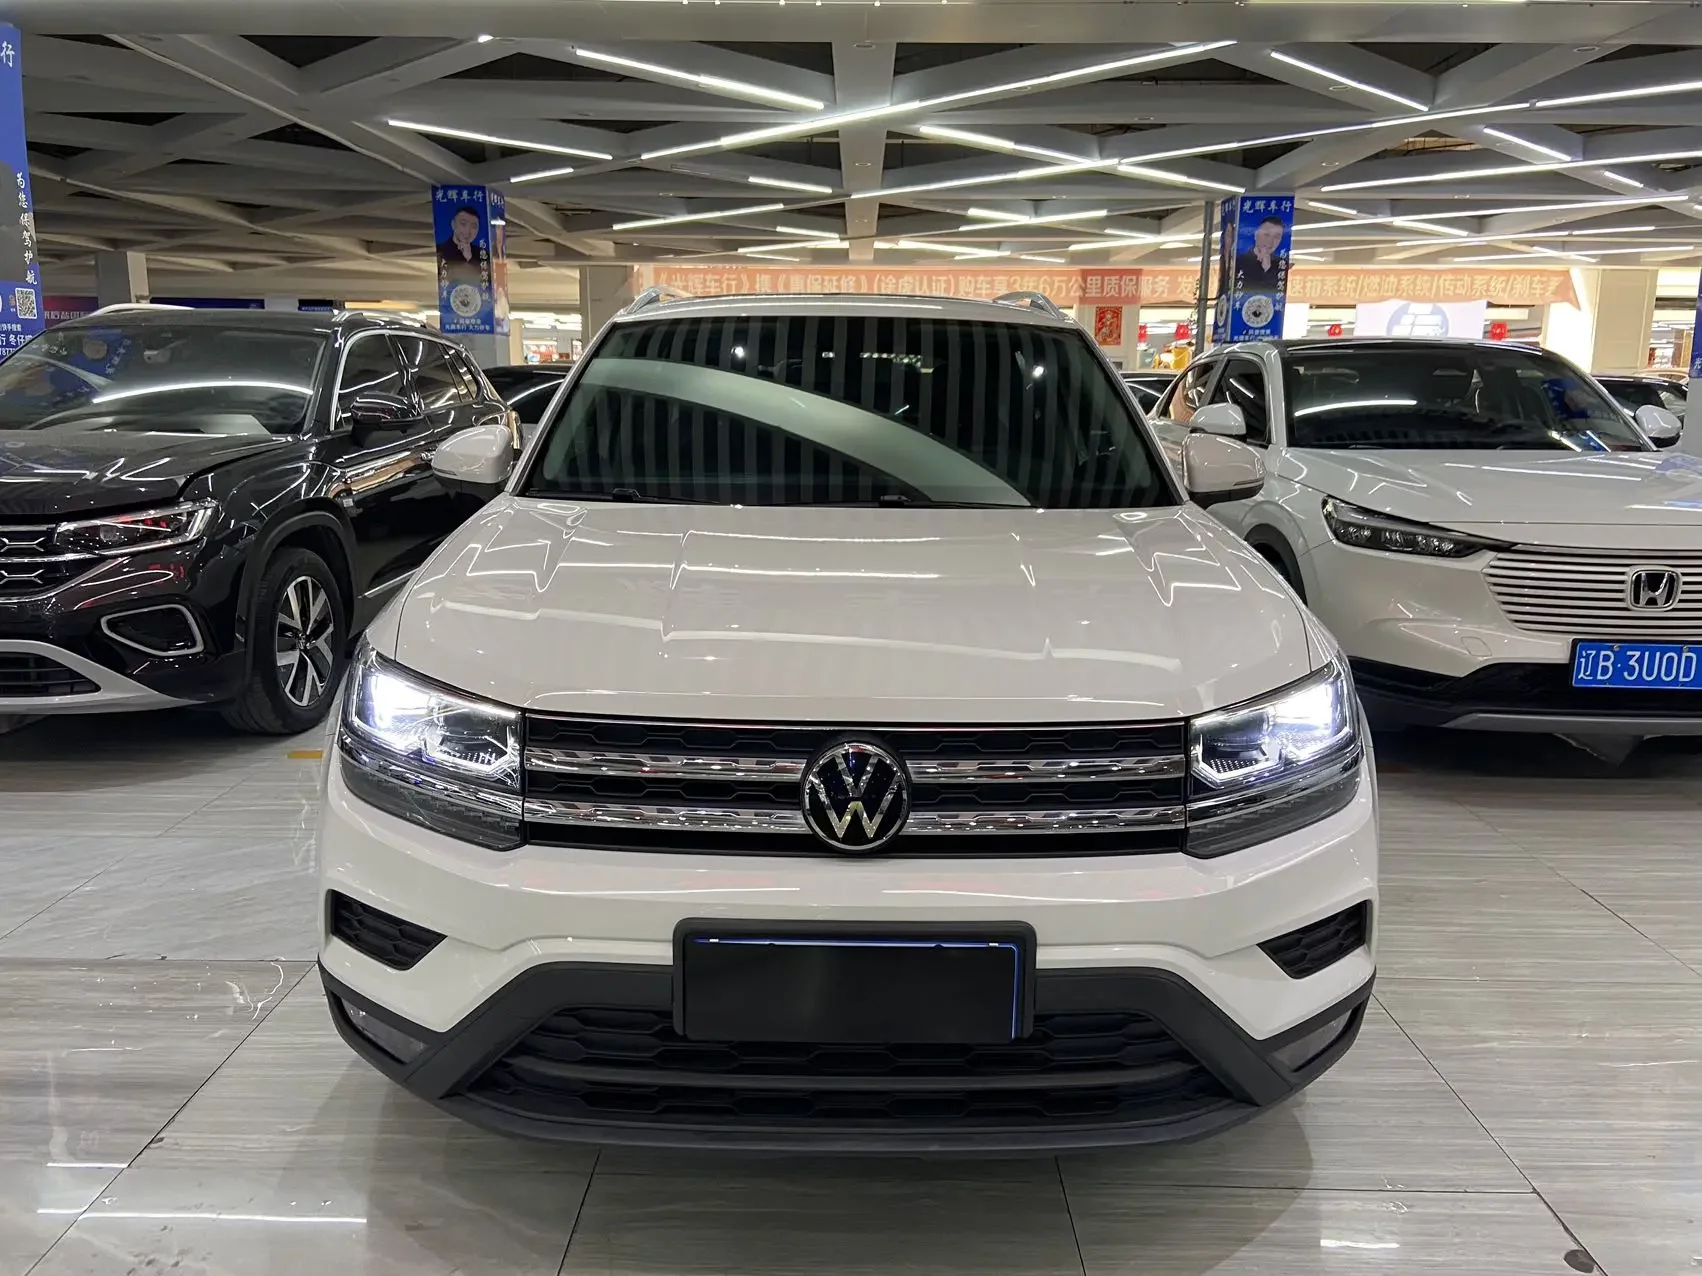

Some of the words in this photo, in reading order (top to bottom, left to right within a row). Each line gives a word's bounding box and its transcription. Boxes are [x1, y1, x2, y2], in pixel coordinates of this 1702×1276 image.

[16, 171, 38, 286] 为您保驾护航
